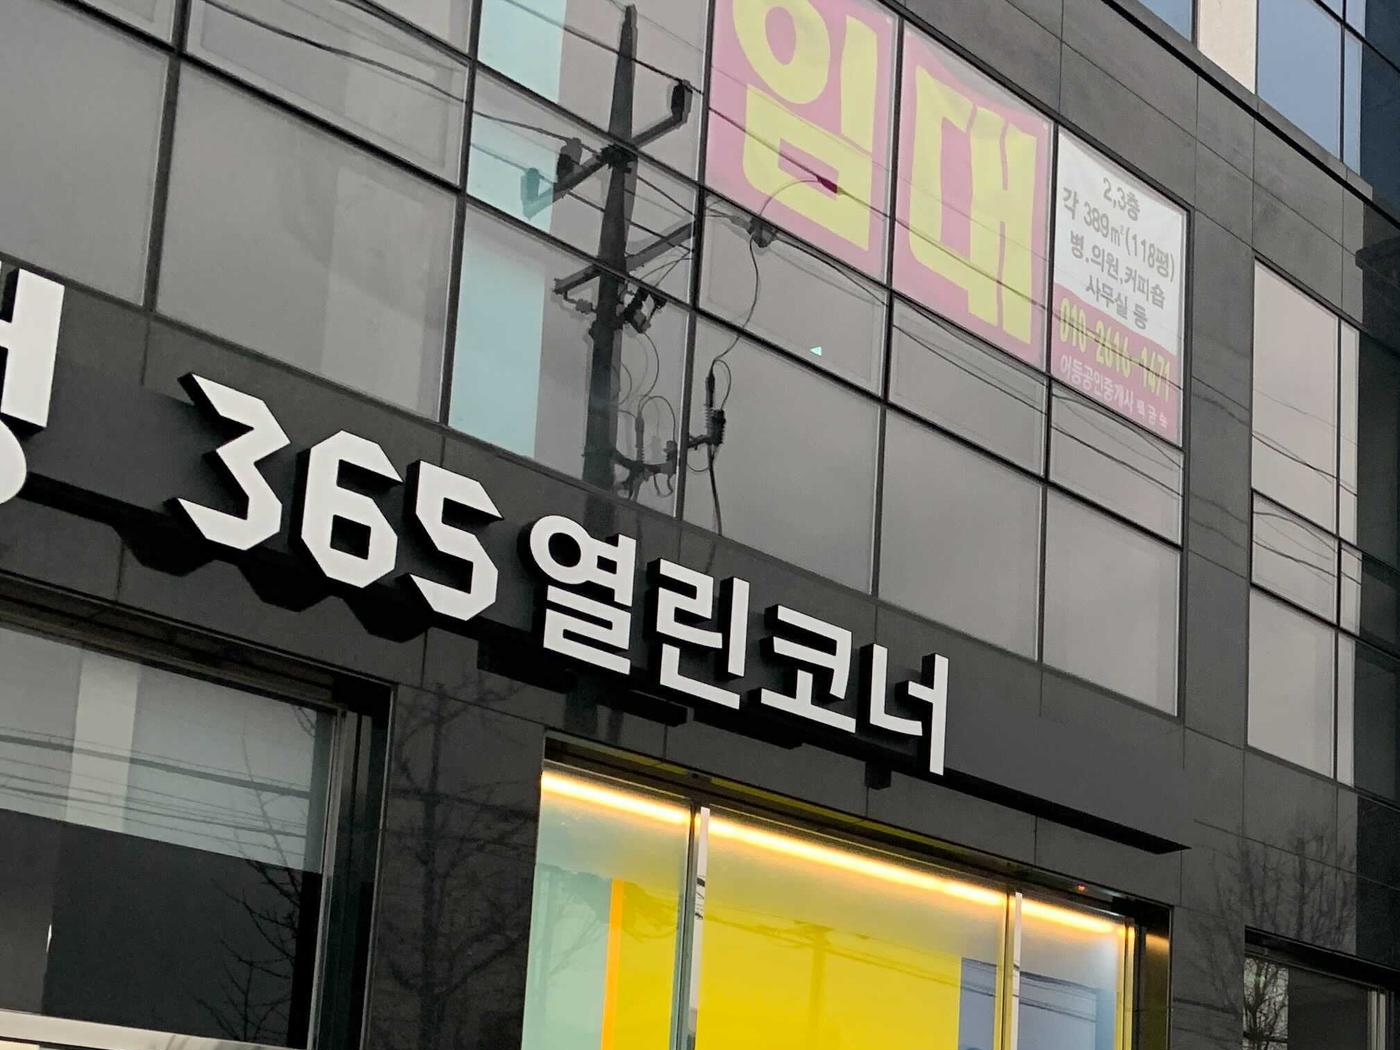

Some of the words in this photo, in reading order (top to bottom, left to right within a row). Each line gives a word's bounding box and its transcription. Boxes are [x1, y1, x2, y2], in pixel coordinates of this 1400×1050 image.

[732, 0, 1037, 344] 임대
[1063, 187, 1080, 220] 각
[1085, 275, 1128, 320] 사무실
[1132, 304, 1148, 330] 등
[177, 373, 503, 620] 365
[529, 515, 949, 776] 열린코너
